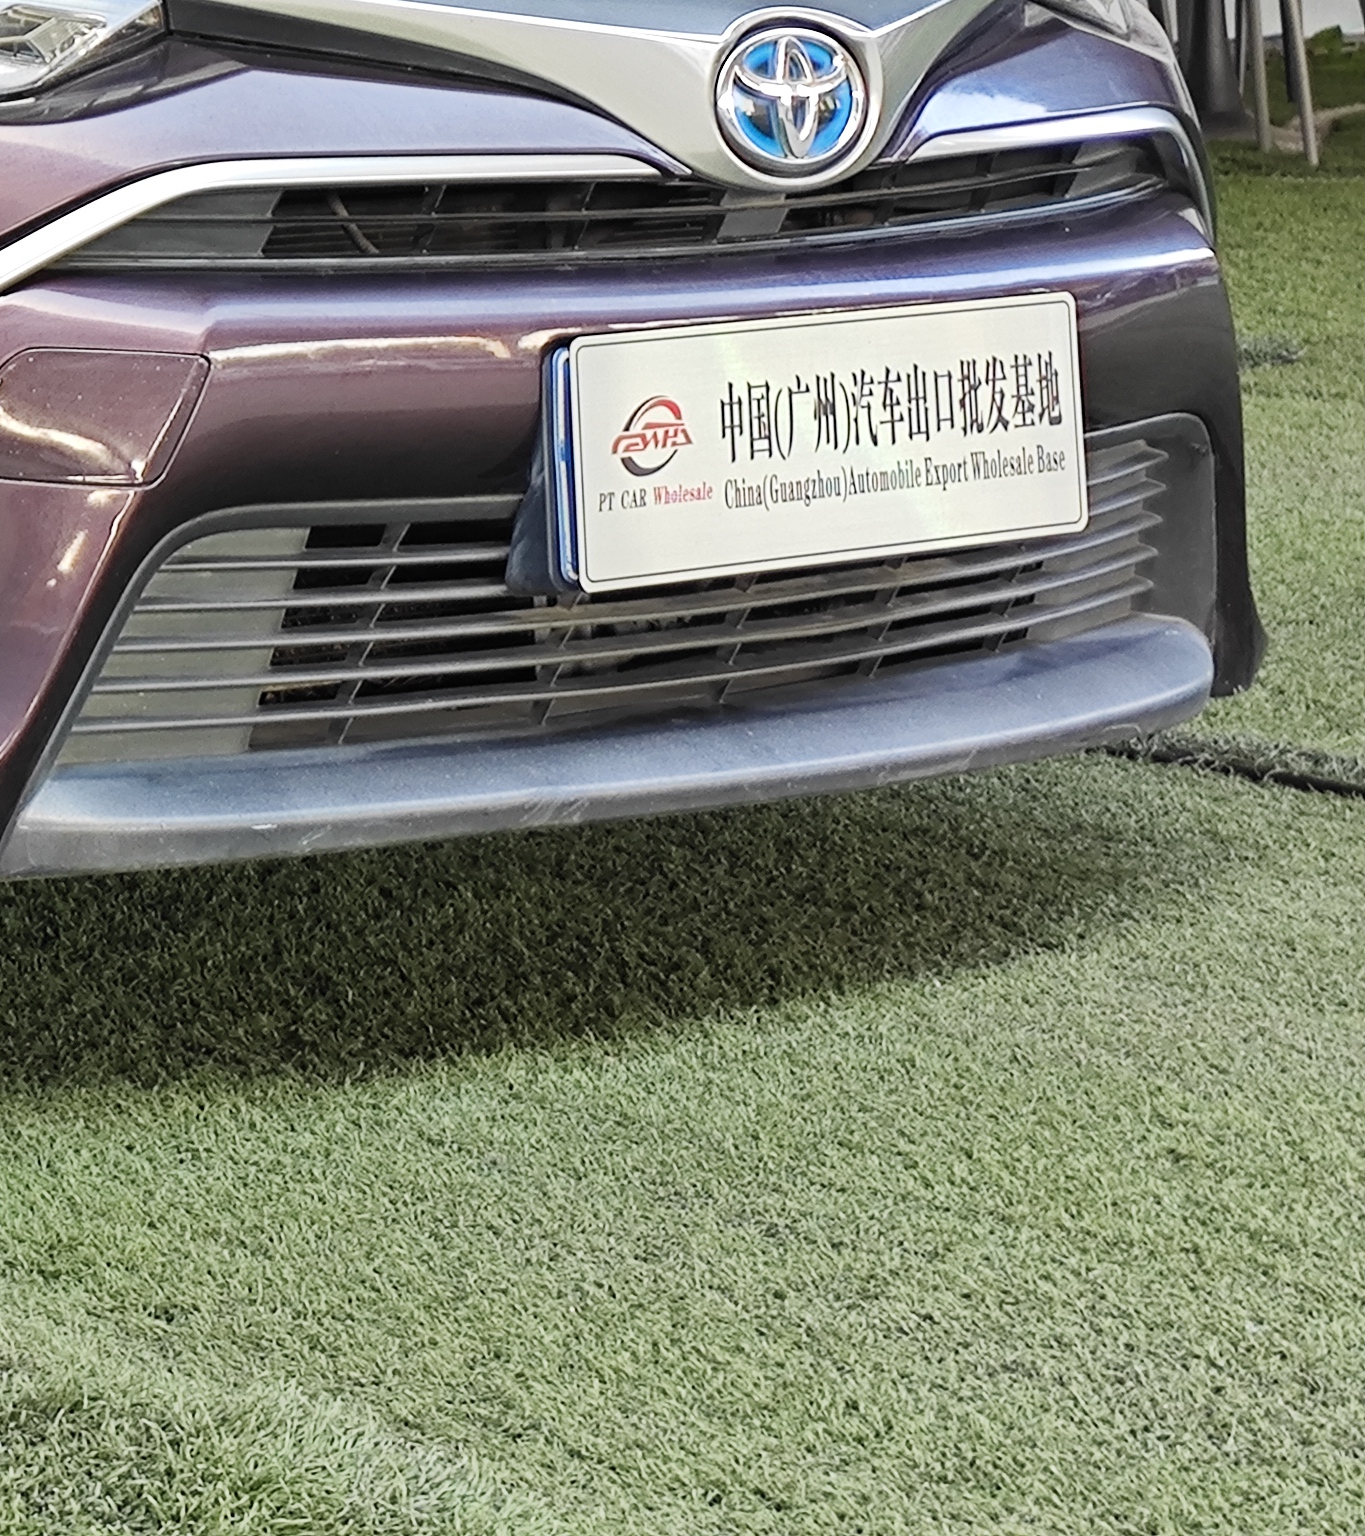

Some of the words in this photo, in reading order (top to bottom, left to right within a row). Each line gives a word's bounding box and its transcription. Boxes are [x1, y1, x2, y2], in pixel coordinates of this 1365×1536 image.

[719, 350, 1064, 463] 中国(广州)汽车出口批发基地
[924, 455, 969, 491] Export
[970, 446, 1034, 481] Wholesale
[1036, 444, 1066, 473] Base
[597, 491, 615, 513] PT
[620, 488, 647, 510] CAR
[653, 481, 714, 506] Wholesale
